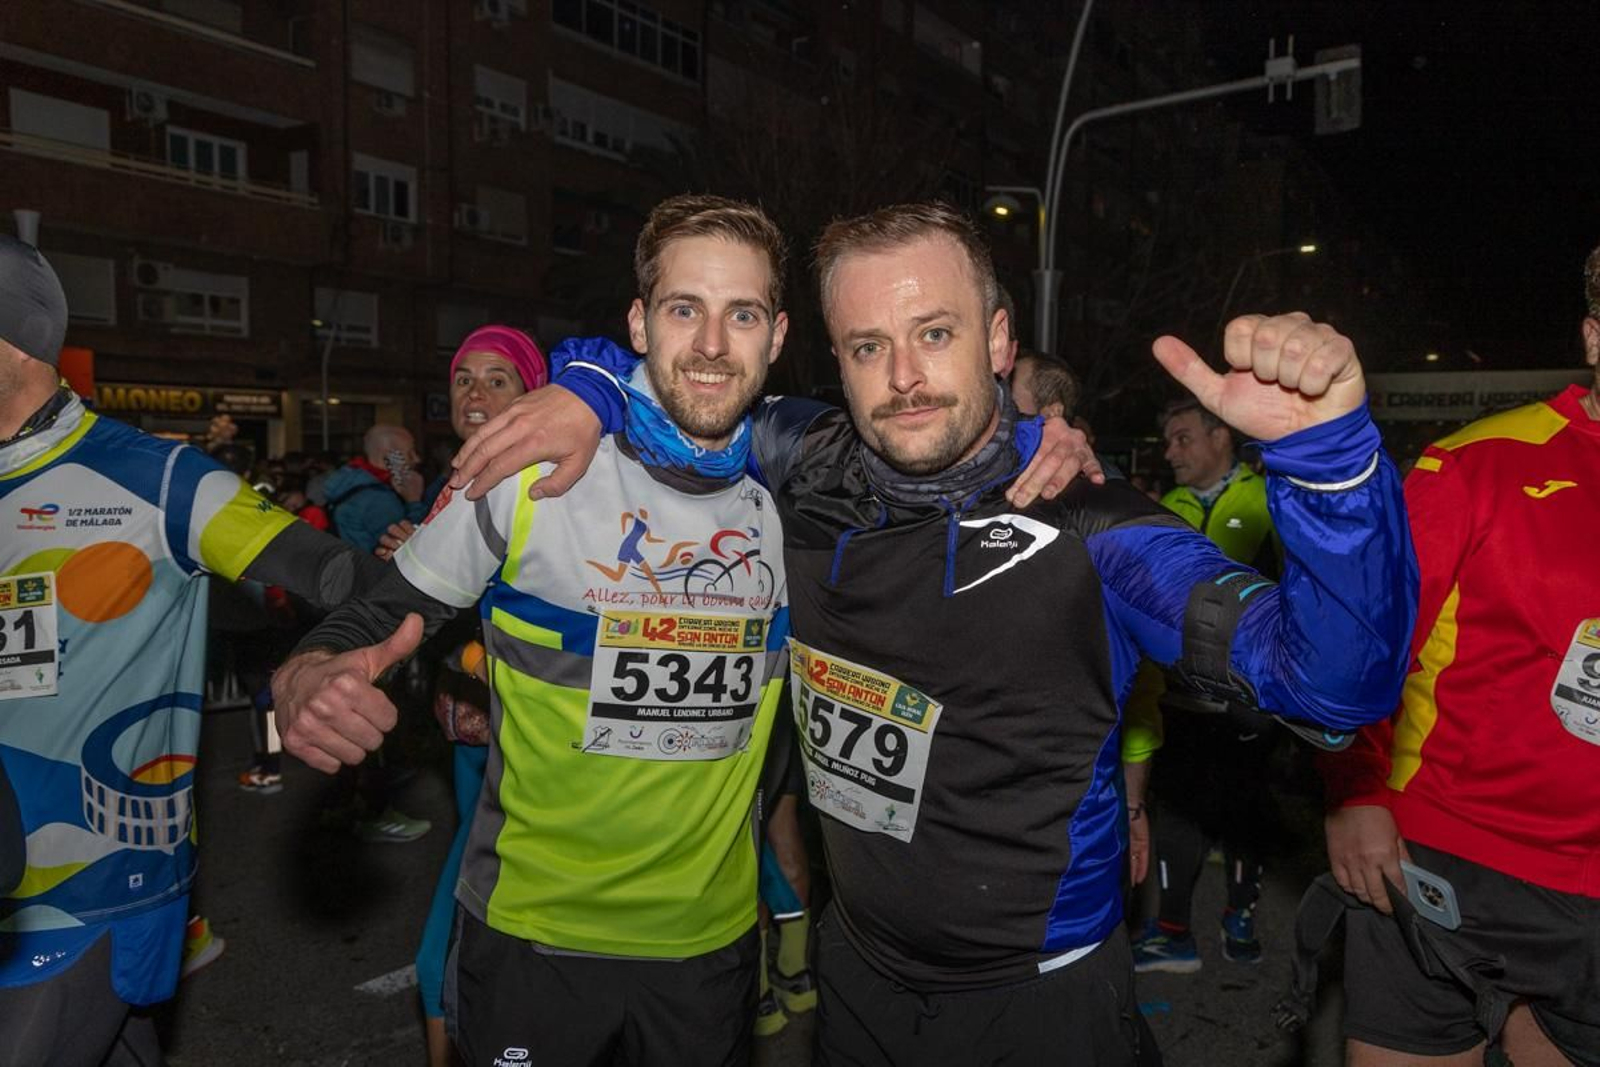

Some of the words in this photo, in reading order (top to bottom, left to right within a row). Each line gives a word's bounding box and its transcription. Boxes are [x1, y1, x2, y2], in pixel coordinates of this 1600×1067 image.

[1388, 392, 1474, 406] CARRERA
[67, 507, 83, 517] 1/2
[84, 505, 133, 517] MARATÓN
[65, 519, 78, 527] DE
[80, 517, 122, 527] MÁLAGA
[0, 609, 36, 652] 1
[642, 617, 677, 642] 42
[676, 631, 701, 642] SAN
[703, 632, 740, 644] ANTON
[610, 651, 754, 703] 5343
[826, 677, 848, 695] SAN
[848, 685, 886, 707] ANTON
[636, 707, 671, 717] MANUEL
[707, 708, 734, 717] URBANO
[799, 683, 909, 777] 5579
[830, 760, 860, 779] MUÑOZ
